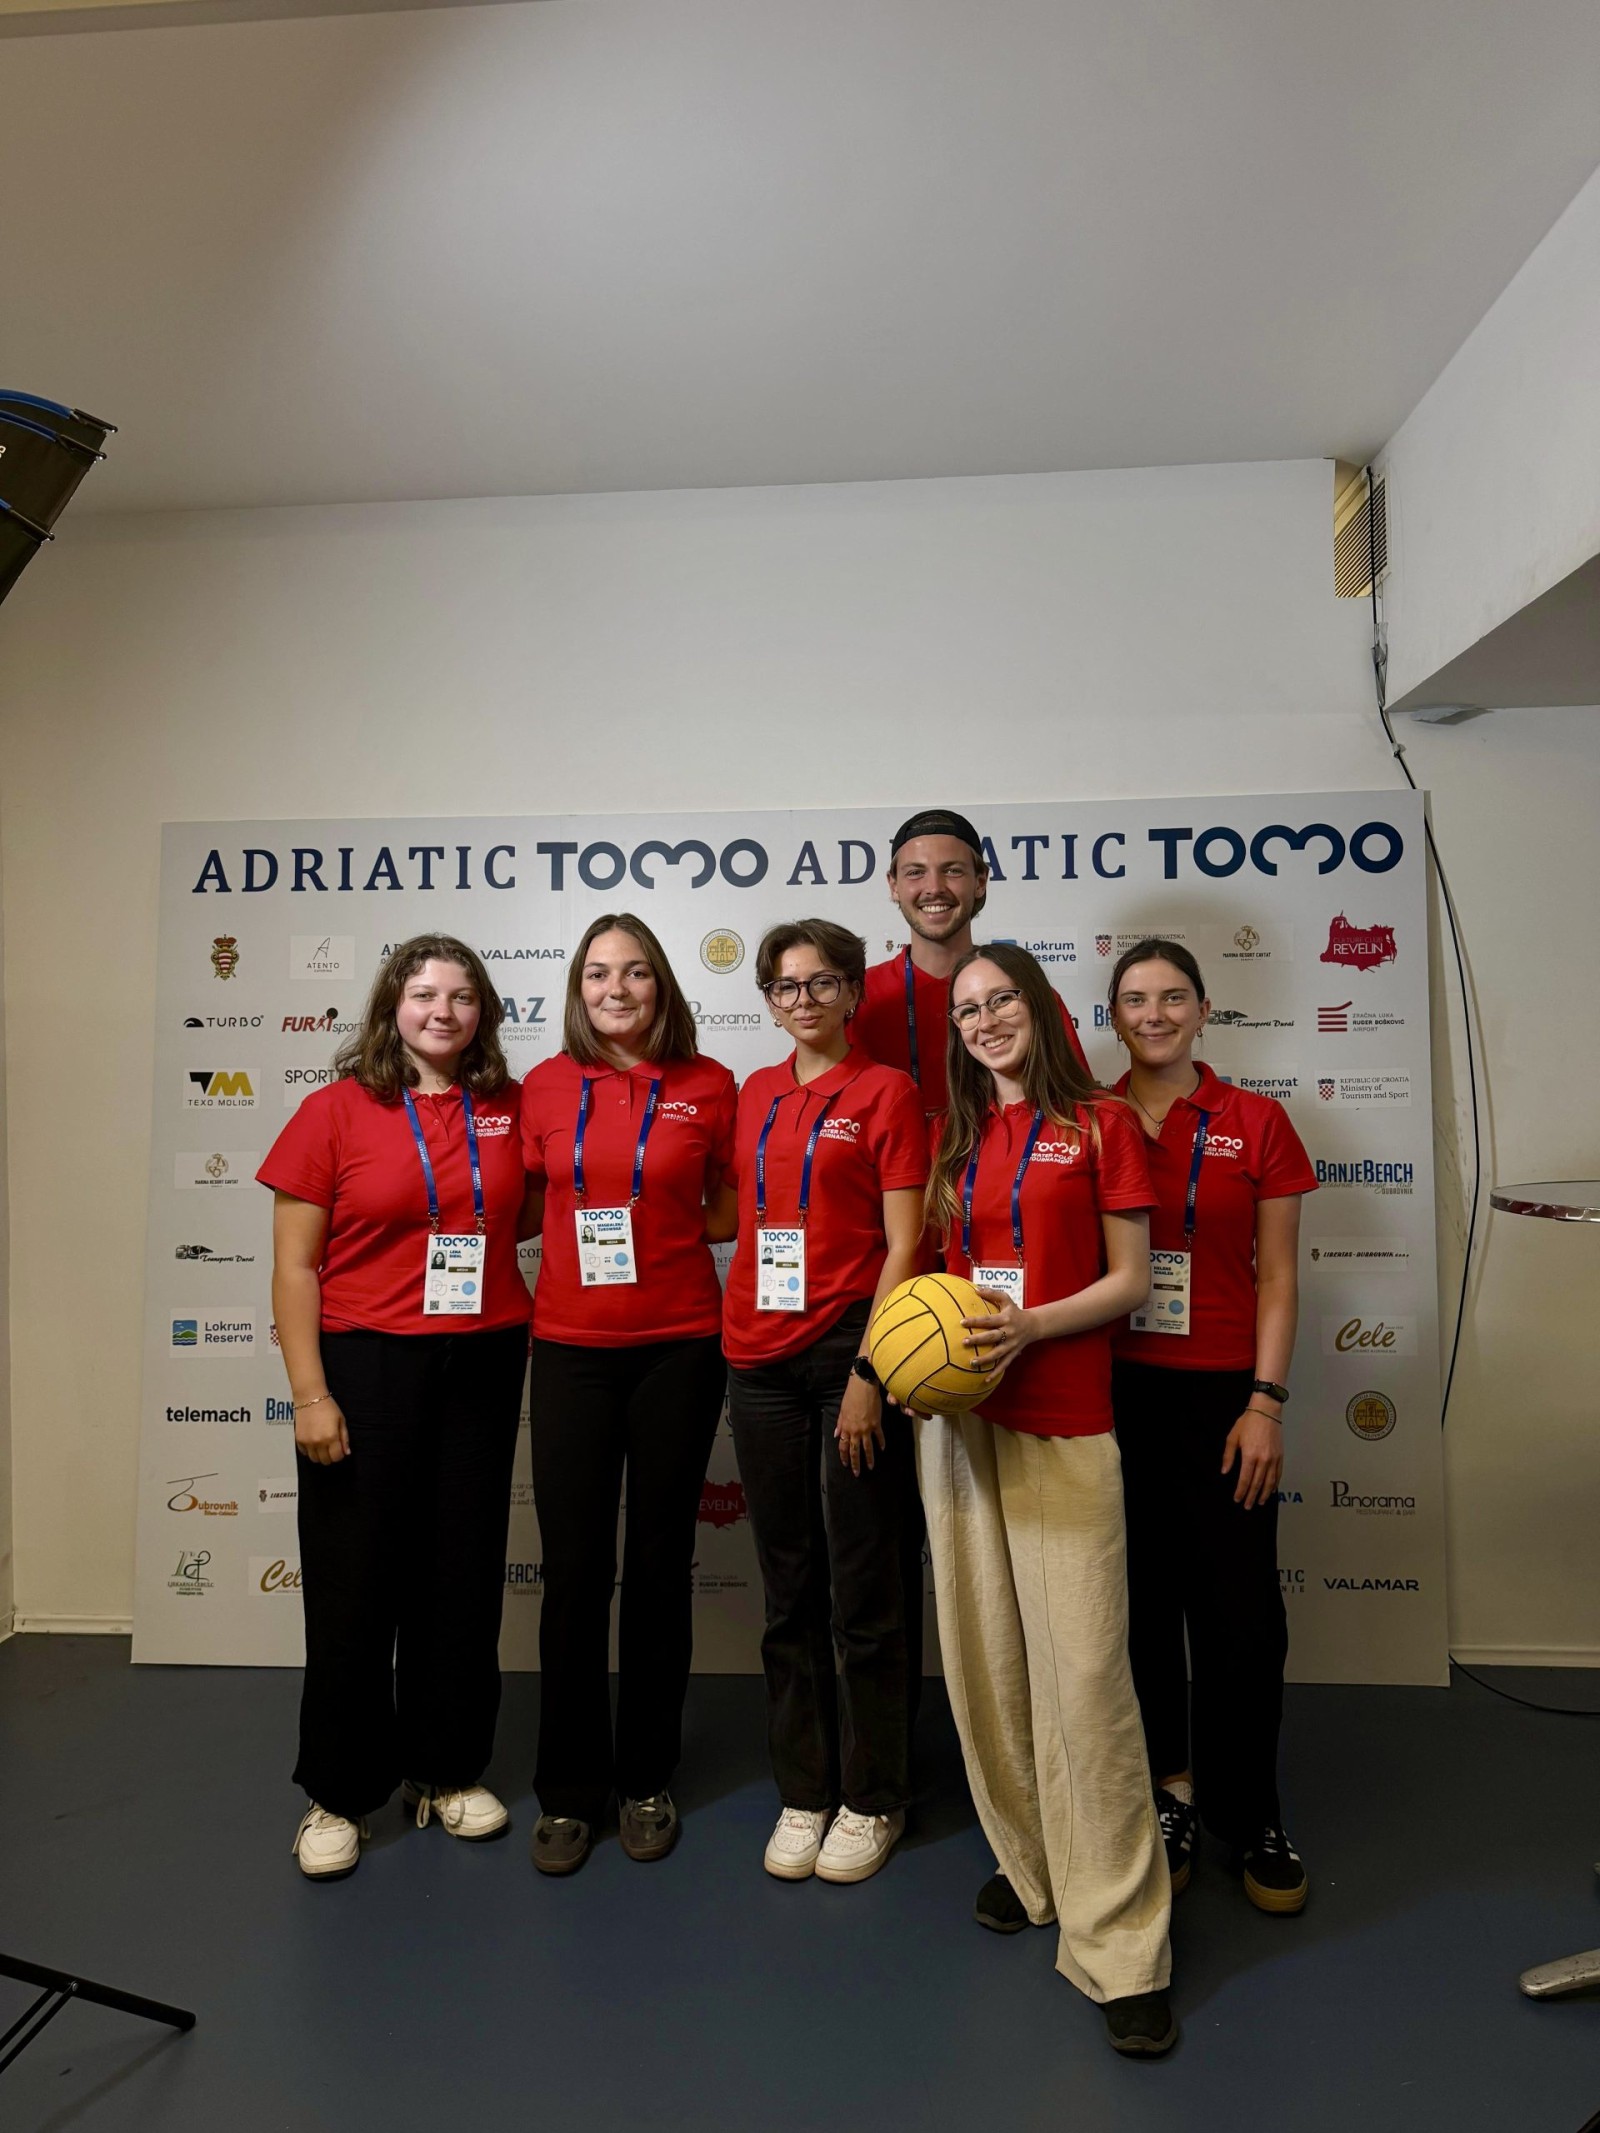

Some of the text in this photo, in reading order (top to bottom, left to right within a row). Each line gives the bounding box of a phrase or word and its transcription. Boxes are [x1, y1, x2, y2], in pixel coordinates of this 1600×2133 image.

[192, 821, 1404, 893] ADRIATIC TOMO ADATIC TOMO
[1025, 940, 1075, 951] Lokrum
[1333, 942, 1384, 955] REVELIN
[480, 949, 566, 960] VALAMAR
[1036, 953, 1077, 962] eserve
[306, 962, 340, 970] ATENTO
[1240, 1077, 1299, 1088] Rezervat
[1340, 1084, 1372, 1092] Ministry
[1373, 1091, 1387, 1099] and
[1389, 1091, 1409, 1100] Sport
[188, 1099, 254, 1107] TEXO MOLIOR
[581, 1210, 624, 1222] TOMO
[435, 1236, 479, 1247] TOMO
[763, 1231, 798, 1242] TOMO
[979, 1270, 1018, 1282] TOMO
[205, 1321, 252, 1332] Lokrum
[205, 1333, 254, 1343] Reserve
[1335, 1318, 1396, 1352] Cele
[166, 1406, 251, 1423] telemach
[1330, 1480, 1416, 1508] Panorama
[699, 1499, 739, 1511] EVELIN
[1324, 1577, 1420, 1592] VALAMAR
